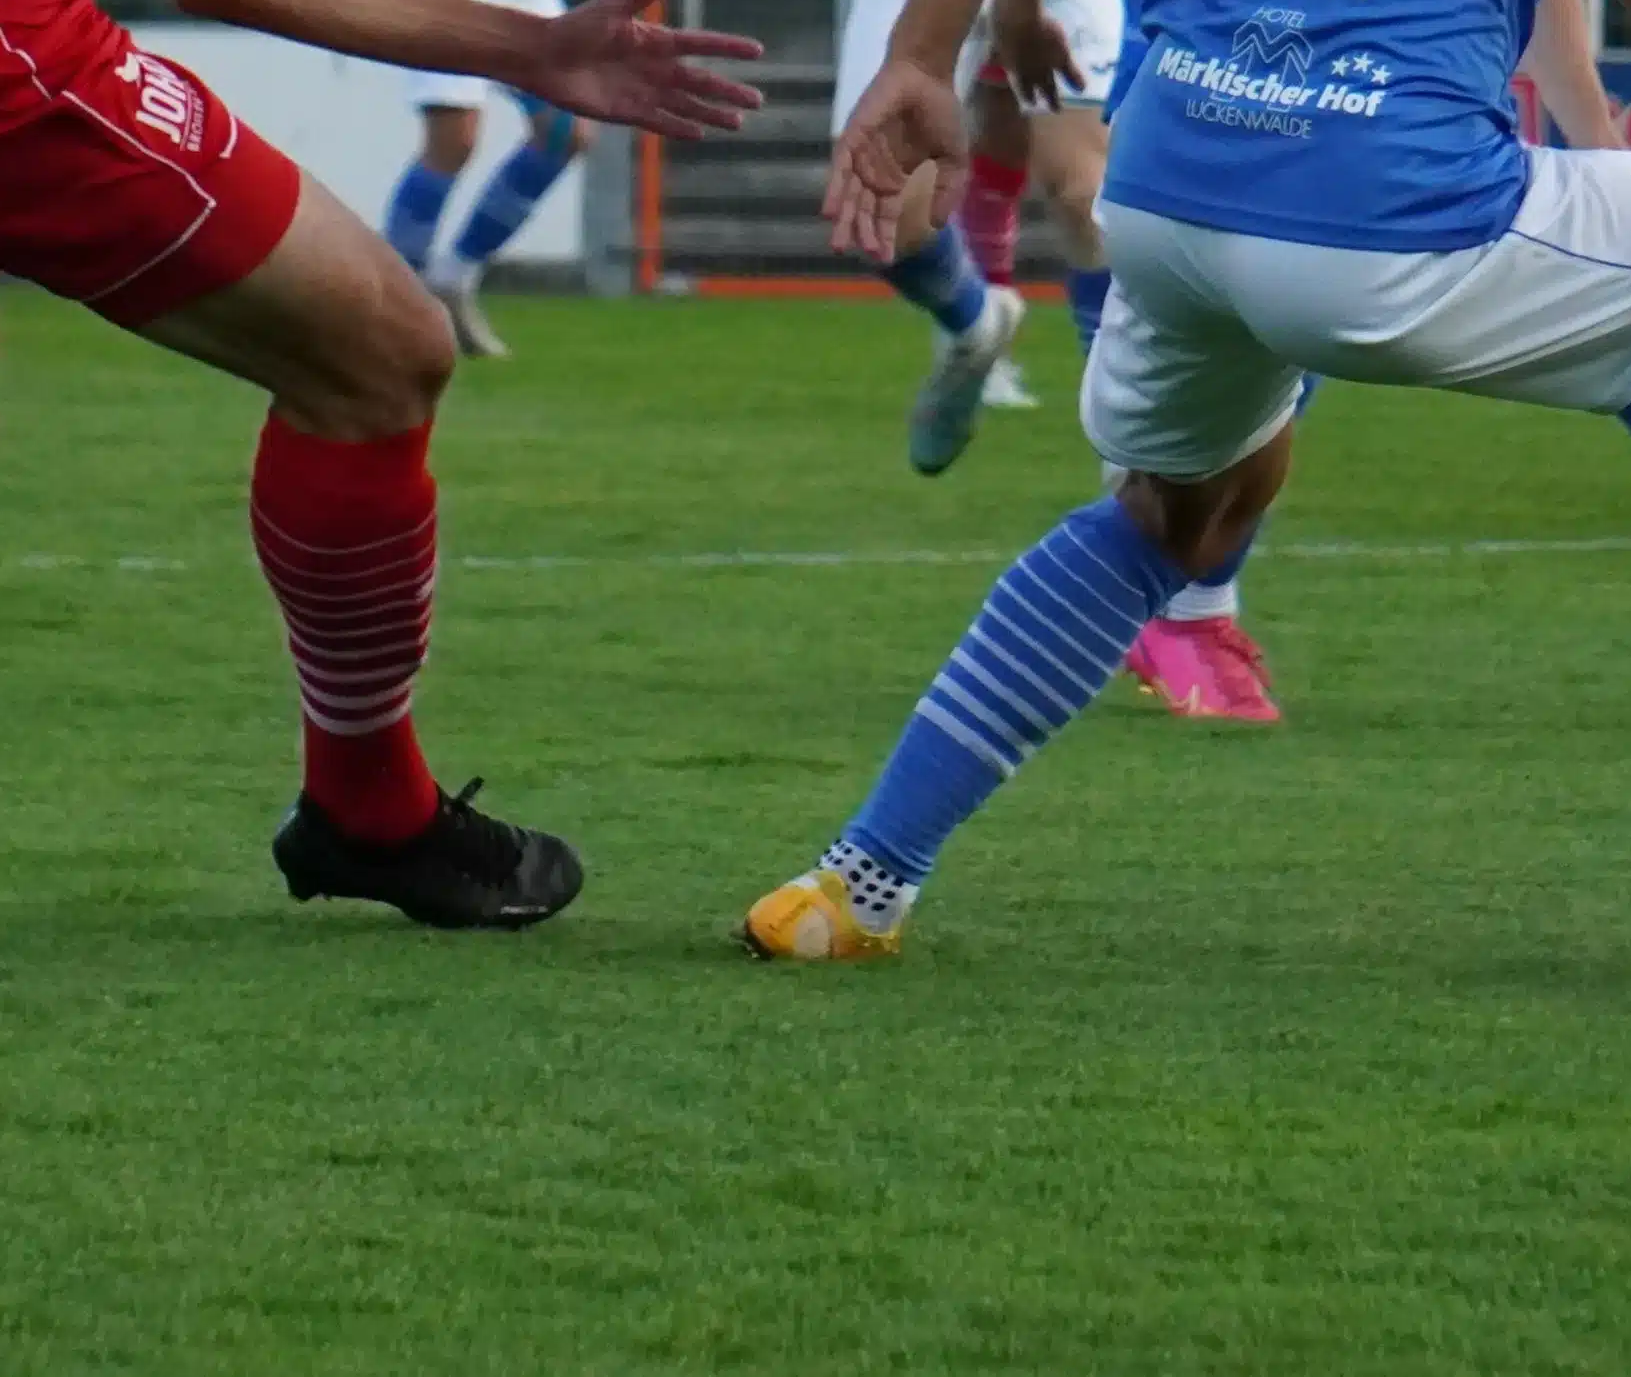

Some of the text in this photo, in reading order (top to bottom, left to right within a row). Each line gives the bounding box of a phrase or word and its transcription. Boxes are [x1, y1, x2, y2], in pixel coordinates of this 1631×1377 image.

[1252, 6, 1308, 29] HOTEL
[1156, 46, 1388, 117] Märkischer Hof
[1184, 98, 1313, 140] LUCKENWALDE
